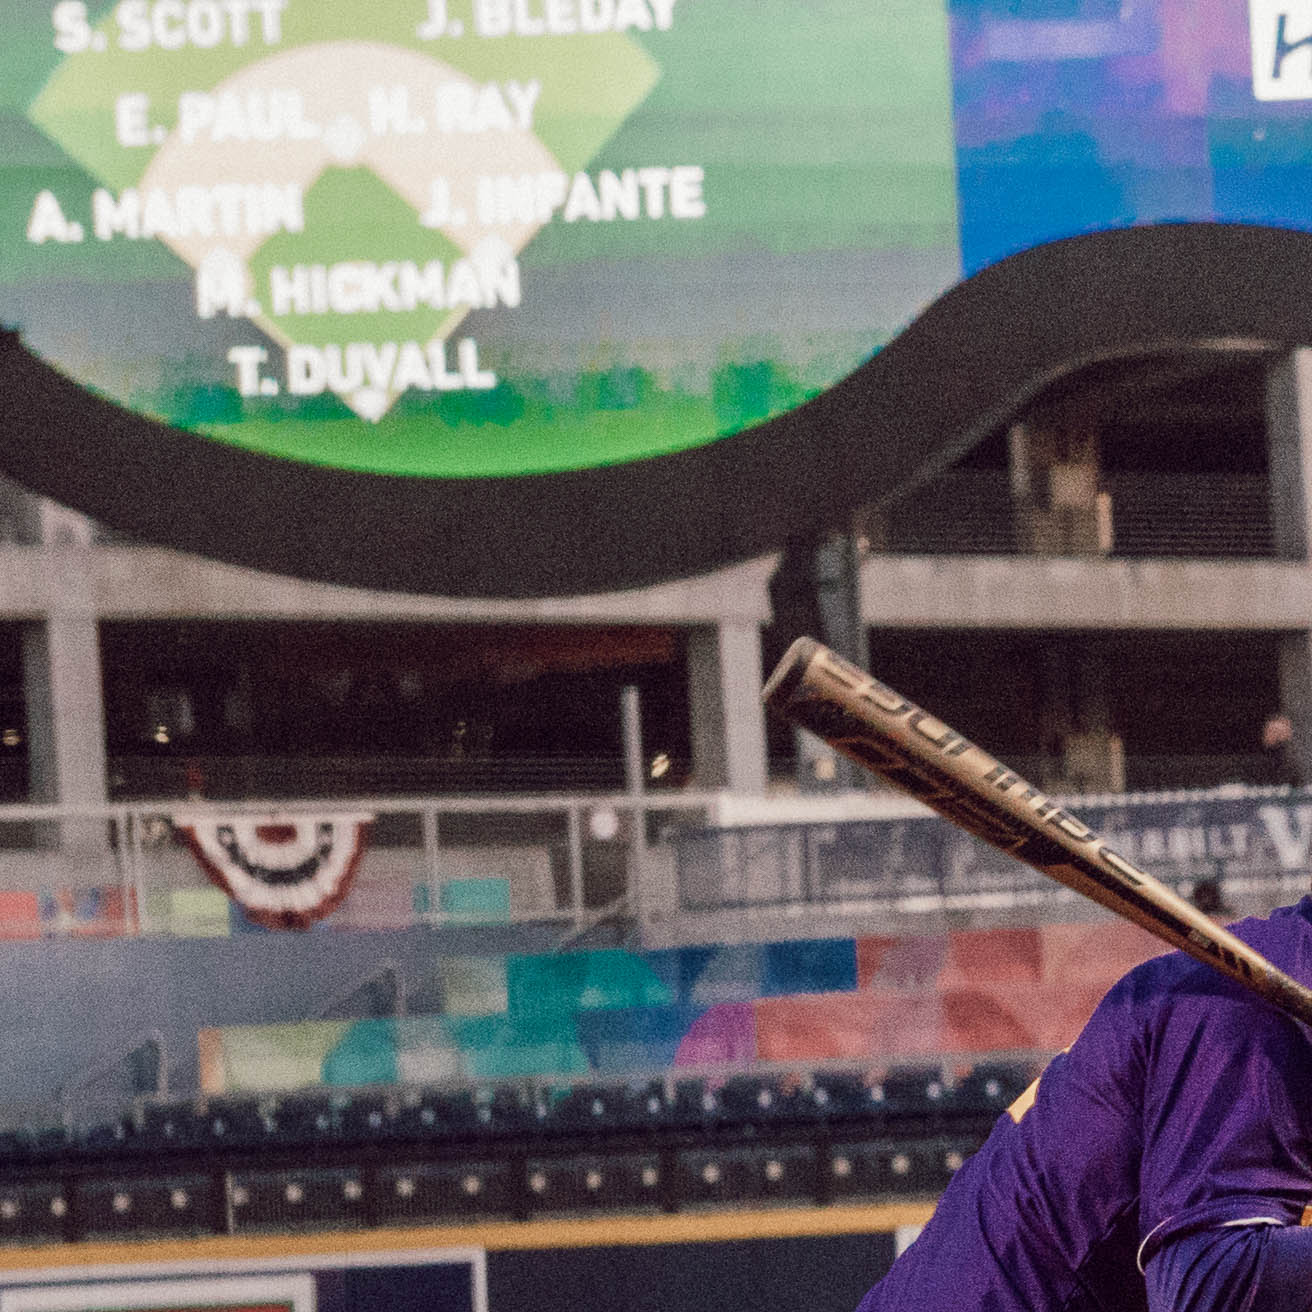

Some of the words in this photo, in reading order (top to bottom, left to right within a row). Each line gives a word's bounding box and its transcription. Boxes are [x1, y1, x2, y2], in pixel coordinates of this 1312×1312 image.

[52, 0, 107, 53] S.
[116, 0, 284, 52] SCOTT
[417, 0, 465, 40] J.
[473, 0, 677, 38] BLEDAY
[116, 92, 166, 147] E.
[179, 88, 322, 144] PAUL
[435, 80, 540, 134] RAY
[27, 189, 84, 244] A.
[93, 182, 304, 240] MARTIN
[421, 175, 468, 228] J.
[271, 256, 521, 316] HICKMAN
[227, 346, 280, 397] T.
[286, 338, 497, 394] DUVALL
